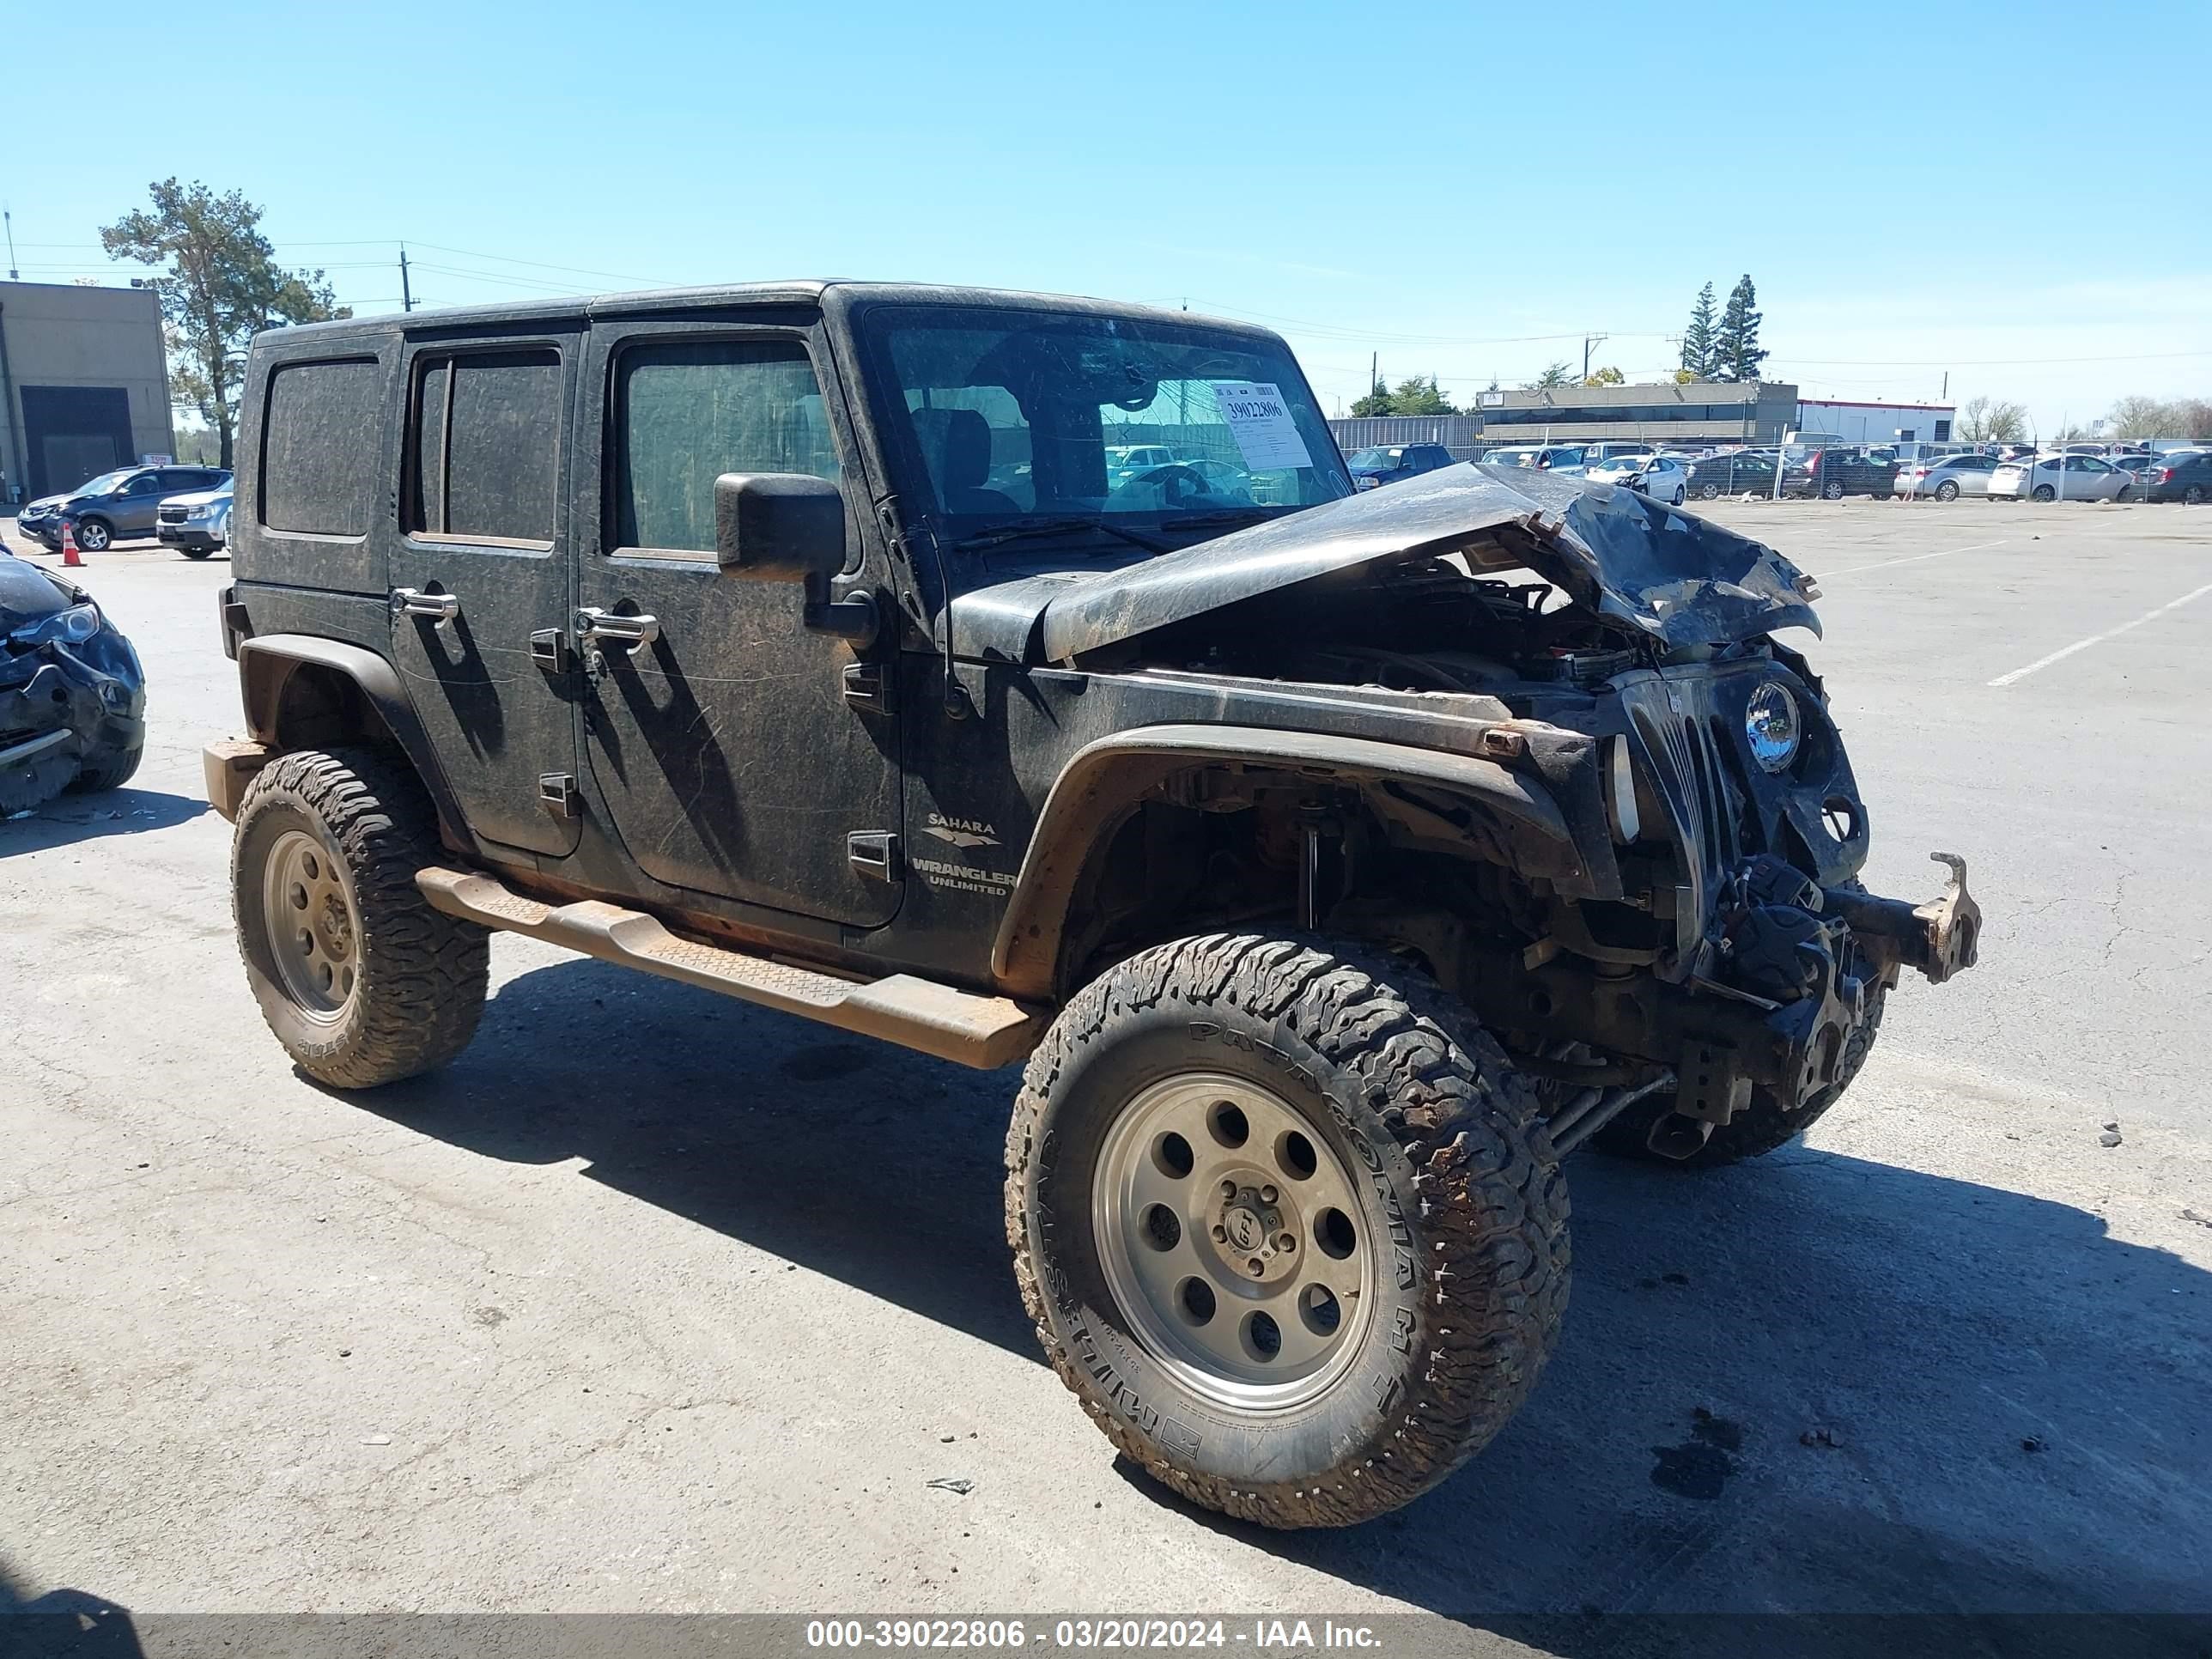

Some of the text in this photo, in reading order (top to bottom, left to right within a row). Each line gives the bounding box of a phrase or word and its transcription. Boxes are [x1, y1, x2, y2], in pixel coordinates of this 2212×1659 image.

[1228, 401, 1283, 418] 39022806
[927, 812, 996, 835] SAHARA
[912, 858, 1018, 888] WRANGLER
[929, 875, 1006, 896] UNLIMITED
[1188, 1021, 1417, 1291] PATAGONIA
[1239, 1210, 1255, 1246] GFX
